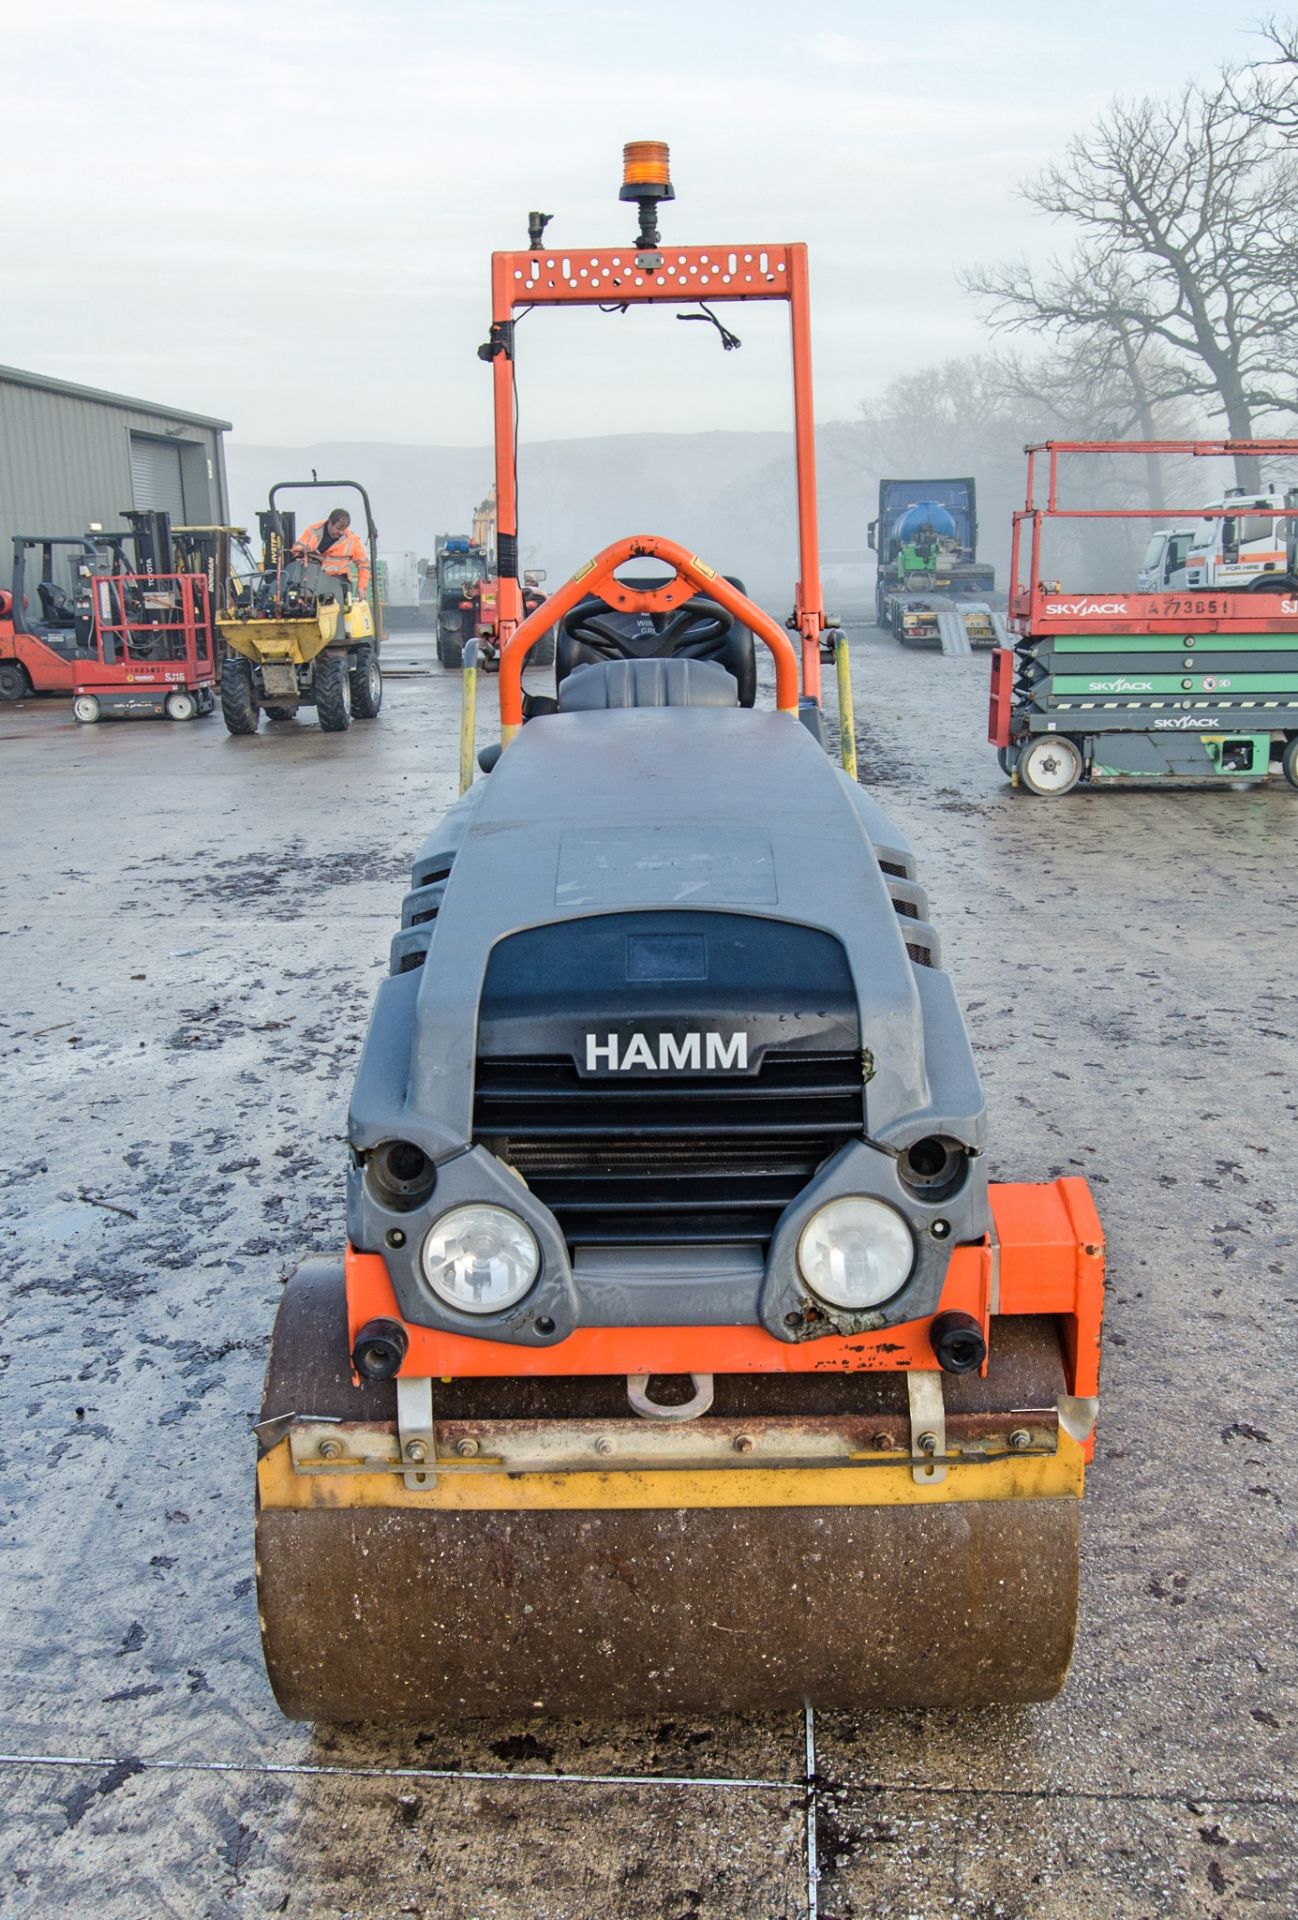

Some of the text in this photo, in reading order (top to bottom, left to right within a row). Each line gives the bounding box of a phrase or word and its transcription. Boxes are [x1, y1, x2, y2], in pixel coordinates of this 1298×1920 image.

[1046, 598, 1127, 617] SKYJACK
[164, 672, 185, 682] SJ16
[1089, 678, 1153, 692] SKYJACK
[1154, 715, 1220, 729] SKYJACK
[585, 1031, 748, 1071] HAMM
